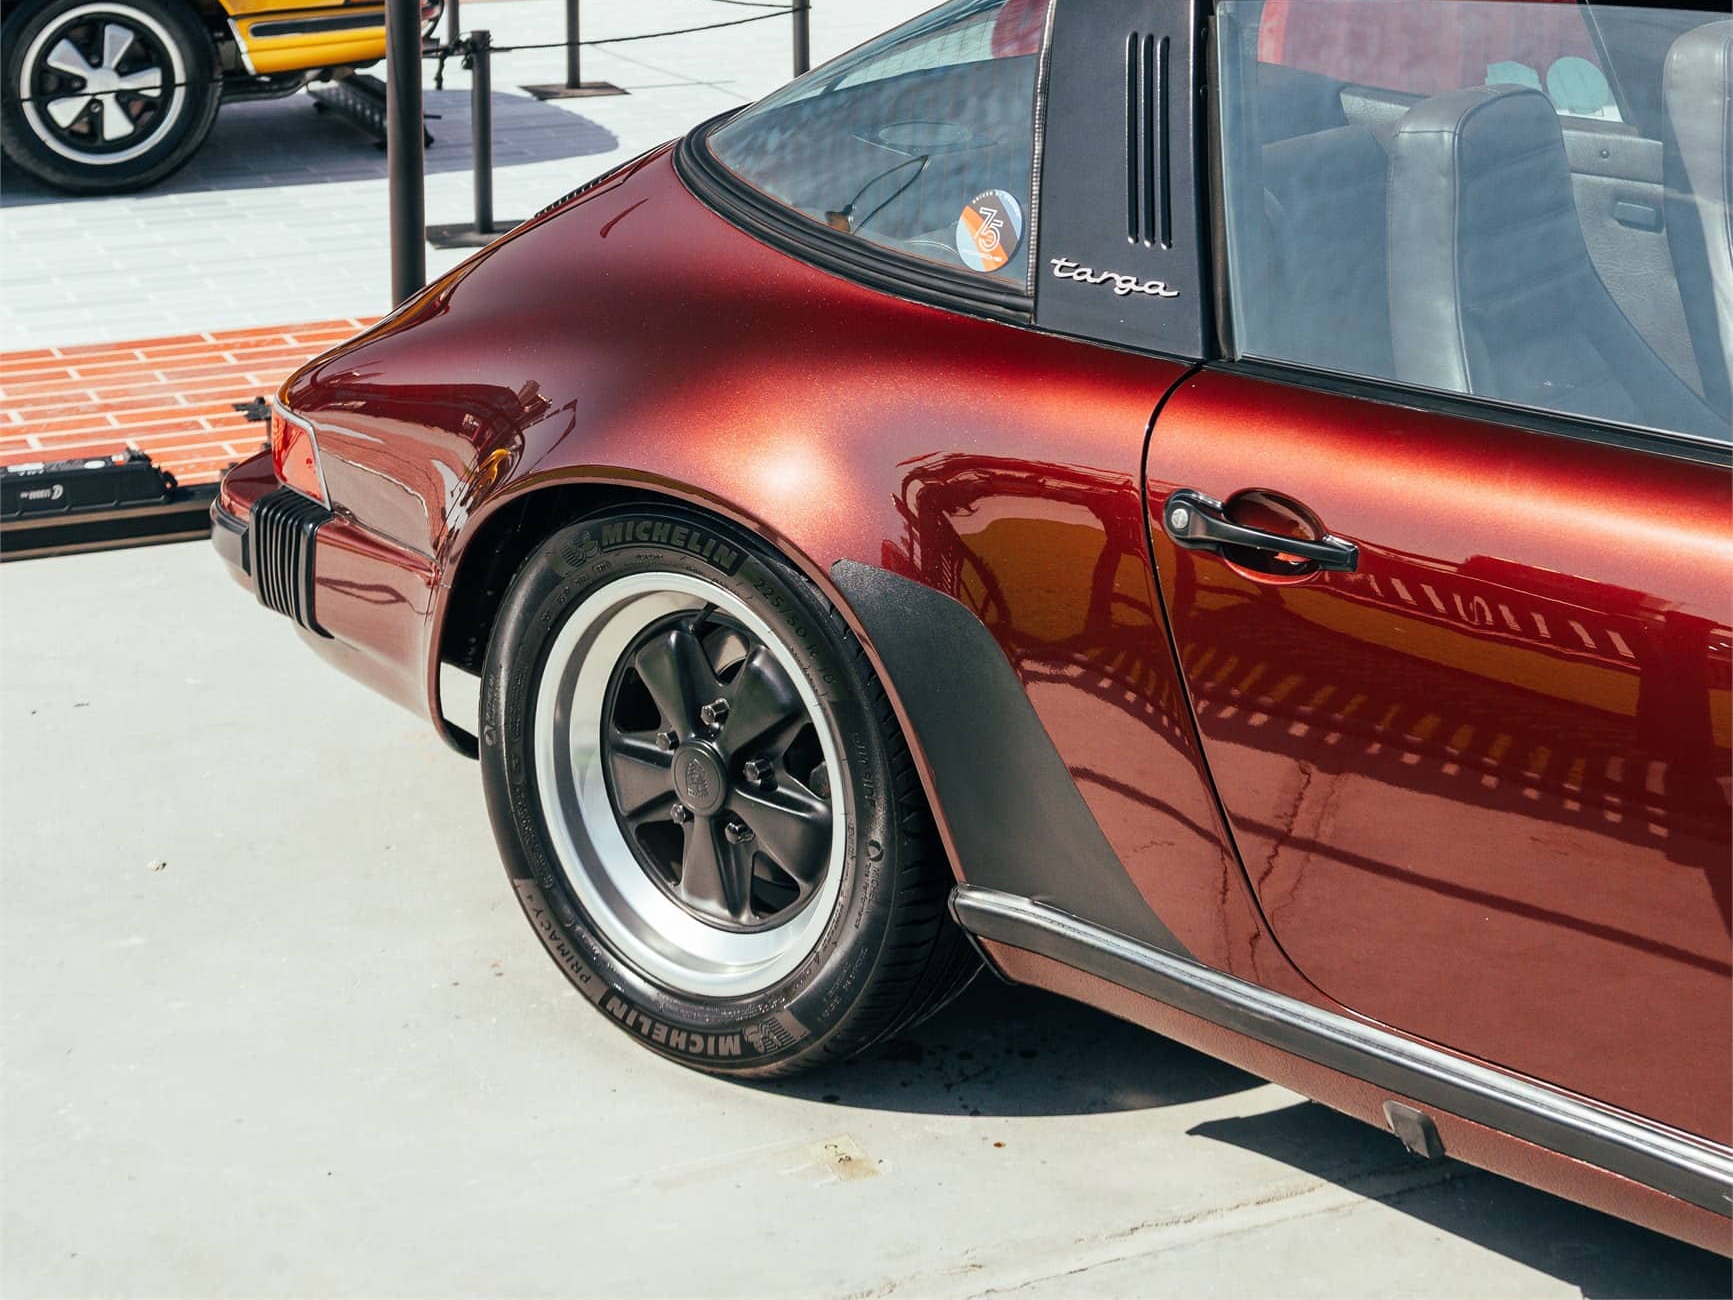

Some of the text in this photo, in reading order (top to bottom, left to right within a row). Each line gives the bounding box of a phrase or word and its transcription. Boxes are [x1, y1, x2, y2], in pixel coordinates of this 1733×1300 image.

[1050, 257, 1181, 297] targa
[602, 520, 739, 570] MICHELIN
[532, 906, 592, 984] PRIMACY
[606, 995, 742, 1057] MICHELIN
